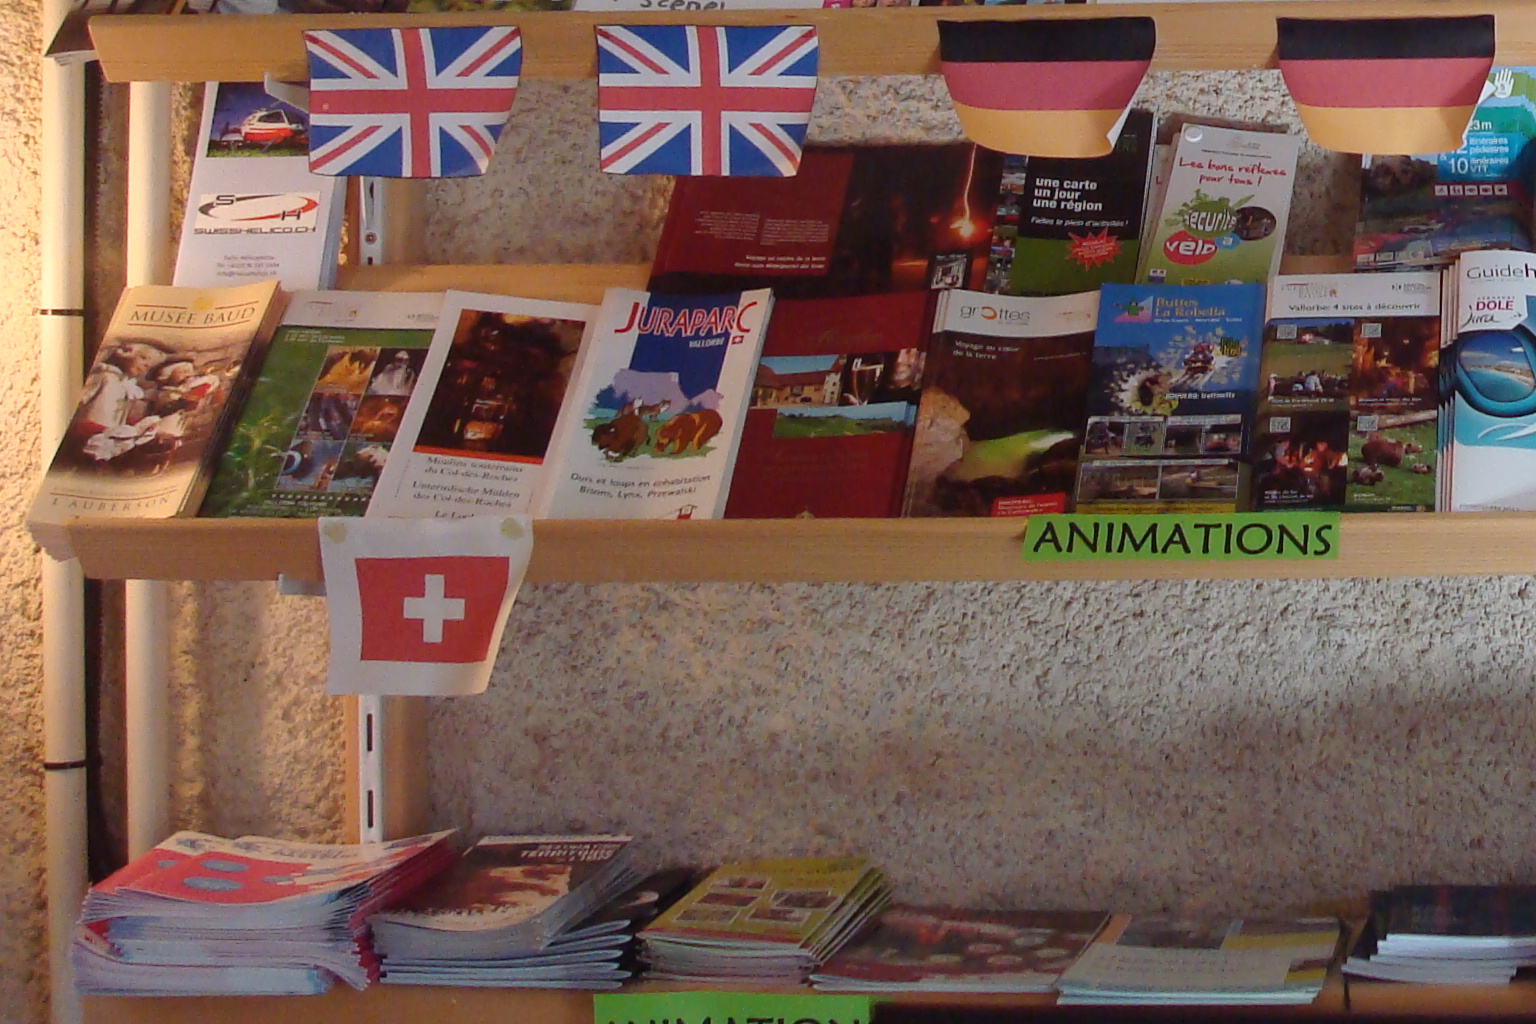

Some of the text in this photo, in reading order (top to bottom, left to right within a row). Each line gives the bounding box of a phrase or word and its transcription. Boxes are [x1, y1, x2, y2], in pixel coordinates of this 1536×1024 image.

[1179, 156, 1204, 169] Les
[1207, 159, 1235, 173] bons
[1448, 157, 1469, 174] 10
[1035, 177, 1098, 190] une carte
[1199, 173, 1224, 185] pour
[1228, 174, 1254, 186] tous
[215, 194, 235, 205] S
[1034, 187, 1082, 200] un jour
[1032, 197, 1103, 213] une région
[281, 209, 301, 221] H
[194, 226, 316, 235] SWISSHELICO.CH
[1165, 237, 1216, 256] vélo
[960, 305, 1031, 321] grottes
[1475, 300, 1514, 312] DOLE
[131, 307, 256, 325] MUSÉE BAUD
[613, 301, 758, 338] JURAPARC
[954, 340, 984, 352] Voyage
[1032, 521, 1333, 556] ANIMATIONS
